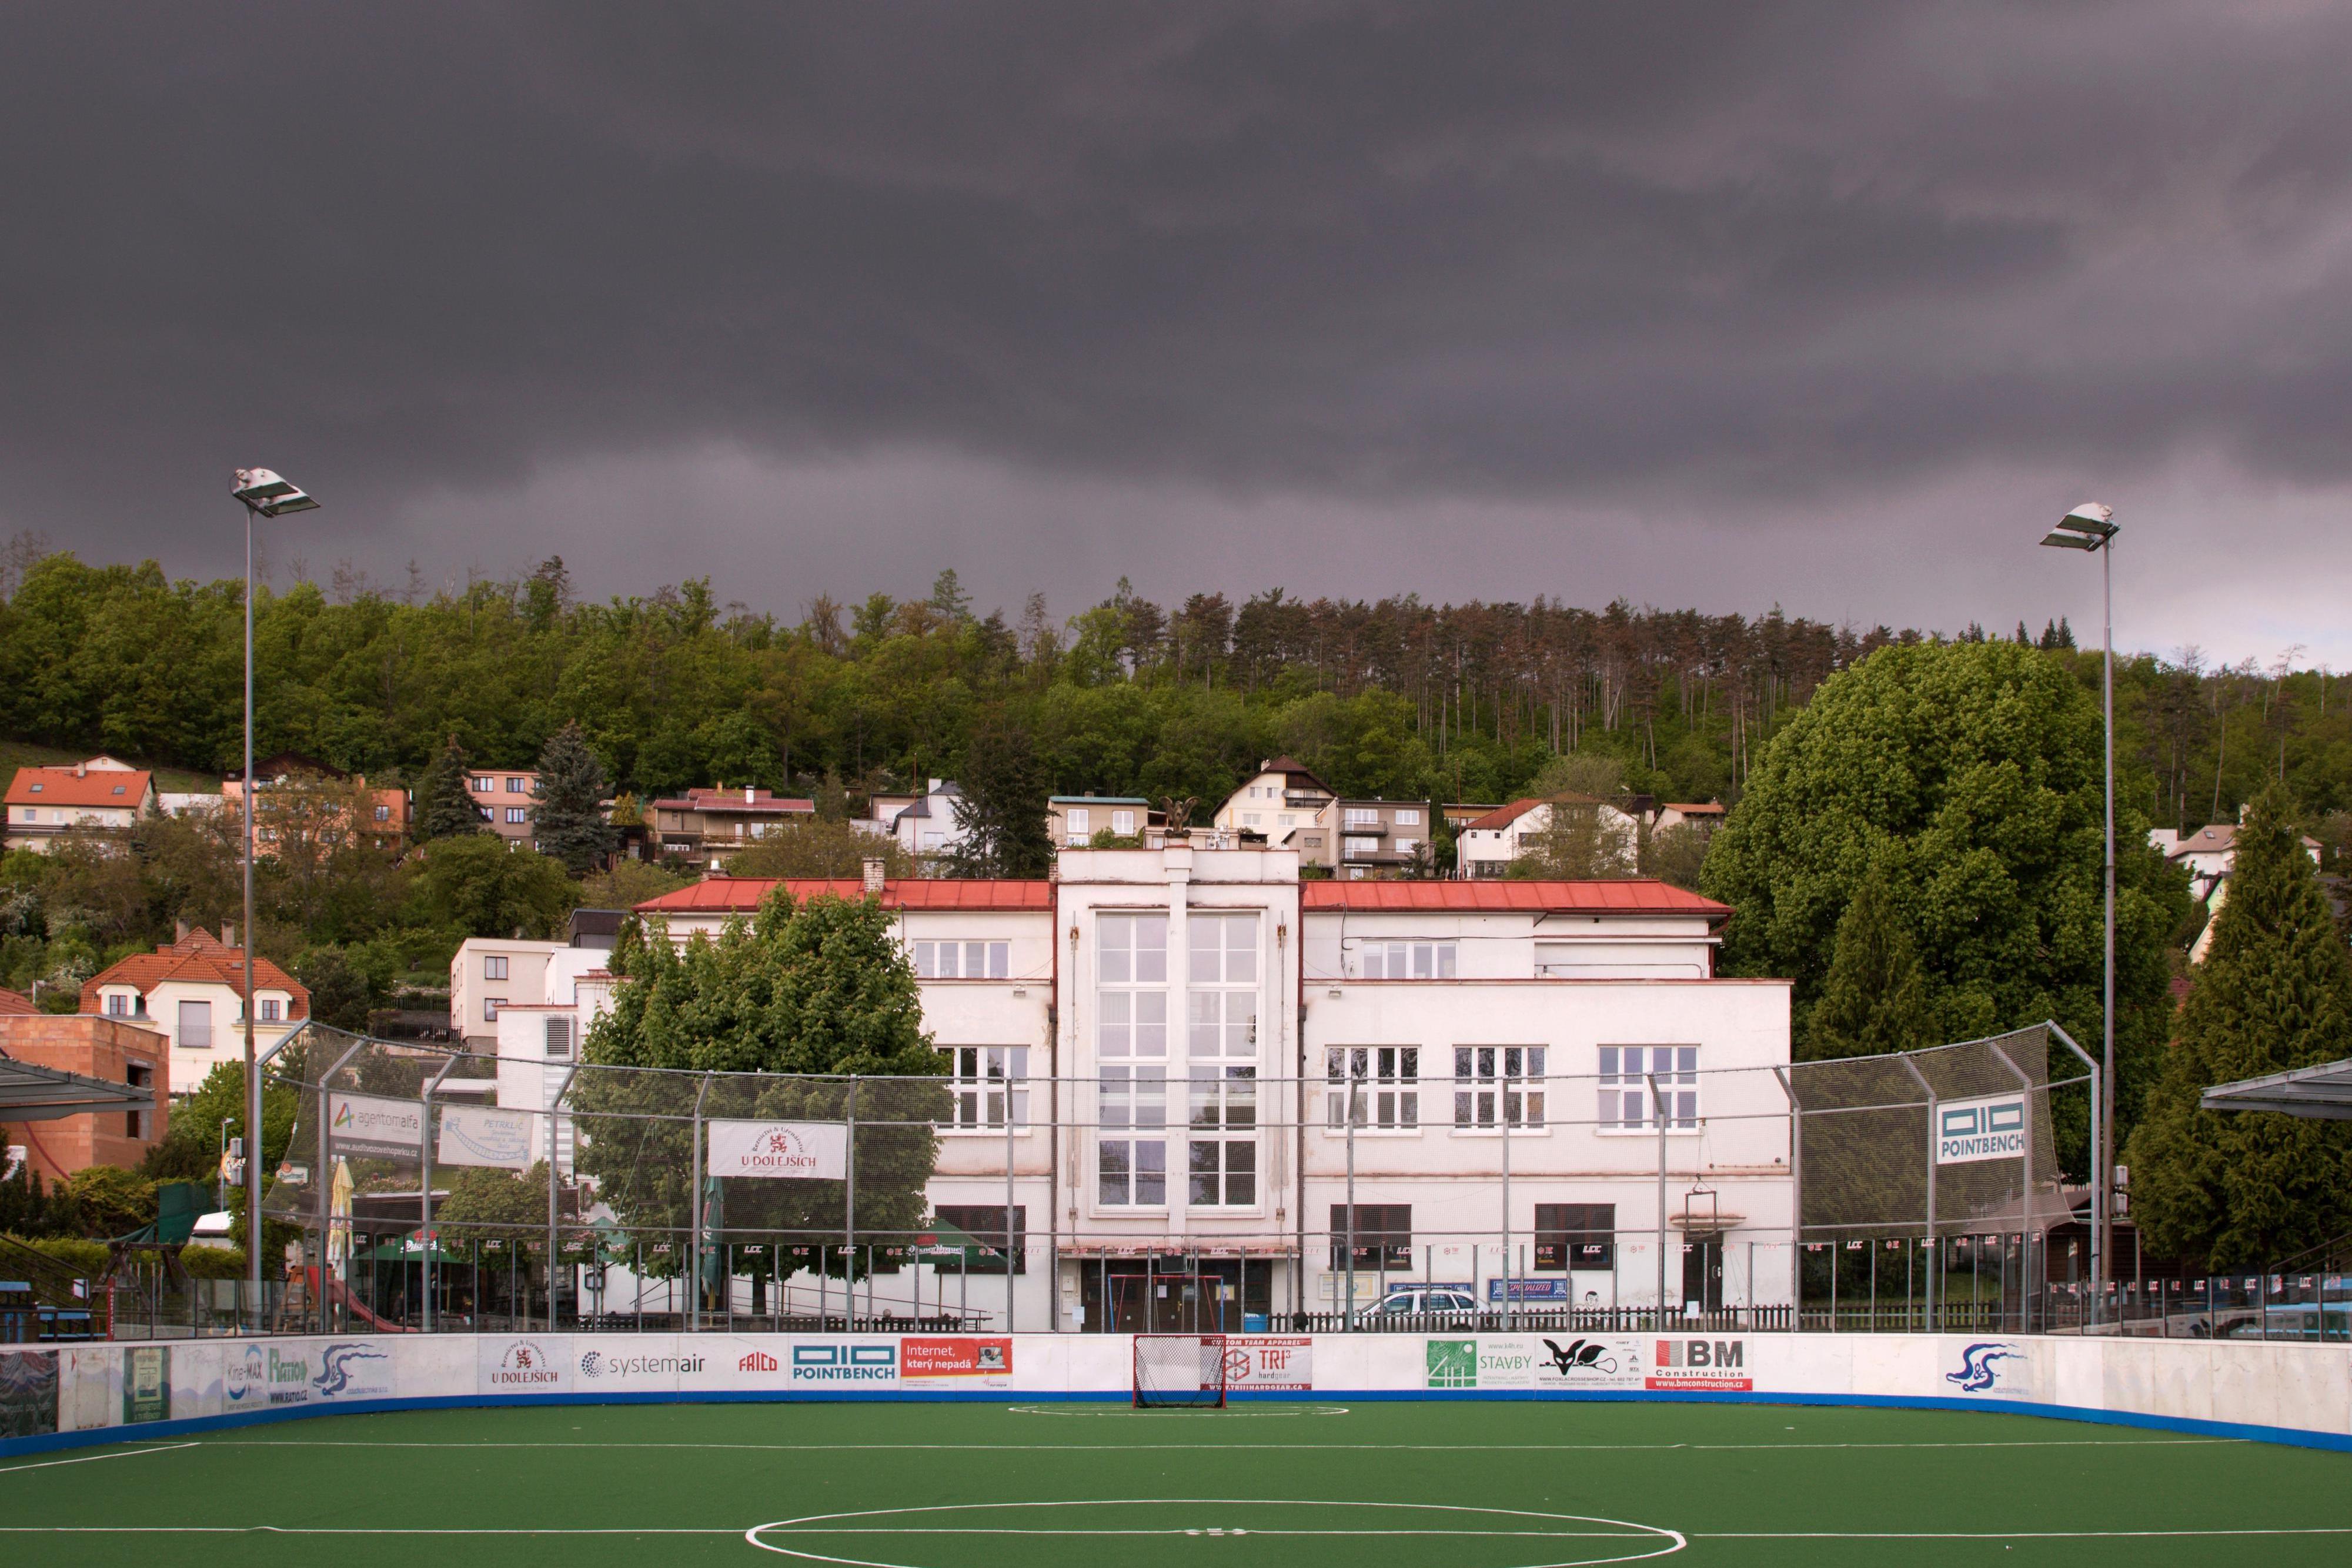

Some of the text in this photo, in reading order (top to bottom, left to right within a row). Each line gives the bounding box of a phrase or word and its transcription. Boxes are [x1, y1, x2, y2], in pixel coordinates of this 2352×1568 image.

[1942, 1134, 2024, 1157] POINTBENCH
[741, 1154, 816, 1166] U DOLEJŠÍCH
[907, 1345, 955, 1357] Internet,
[1688, 1340, 1743, 1368] BM
[610, 1353, 705, 1378] systemair
[739, 1352, 777, 1371] FRICO
[907, 1359, 971, 1370] který nepadá
[1480, 1356, 1532, 1369] STAVBY
[492, 1369, 558, 1383] U DOLEJŠÍCH
[794, 1368, 895, 1379] POINTBENCH
[1259, 1372, 1291, 1380] hardgear
[1656, 1369, 1743, 1378] Construction
[1656, 1379, 1743, 1388] www.bmconstruction.cz
